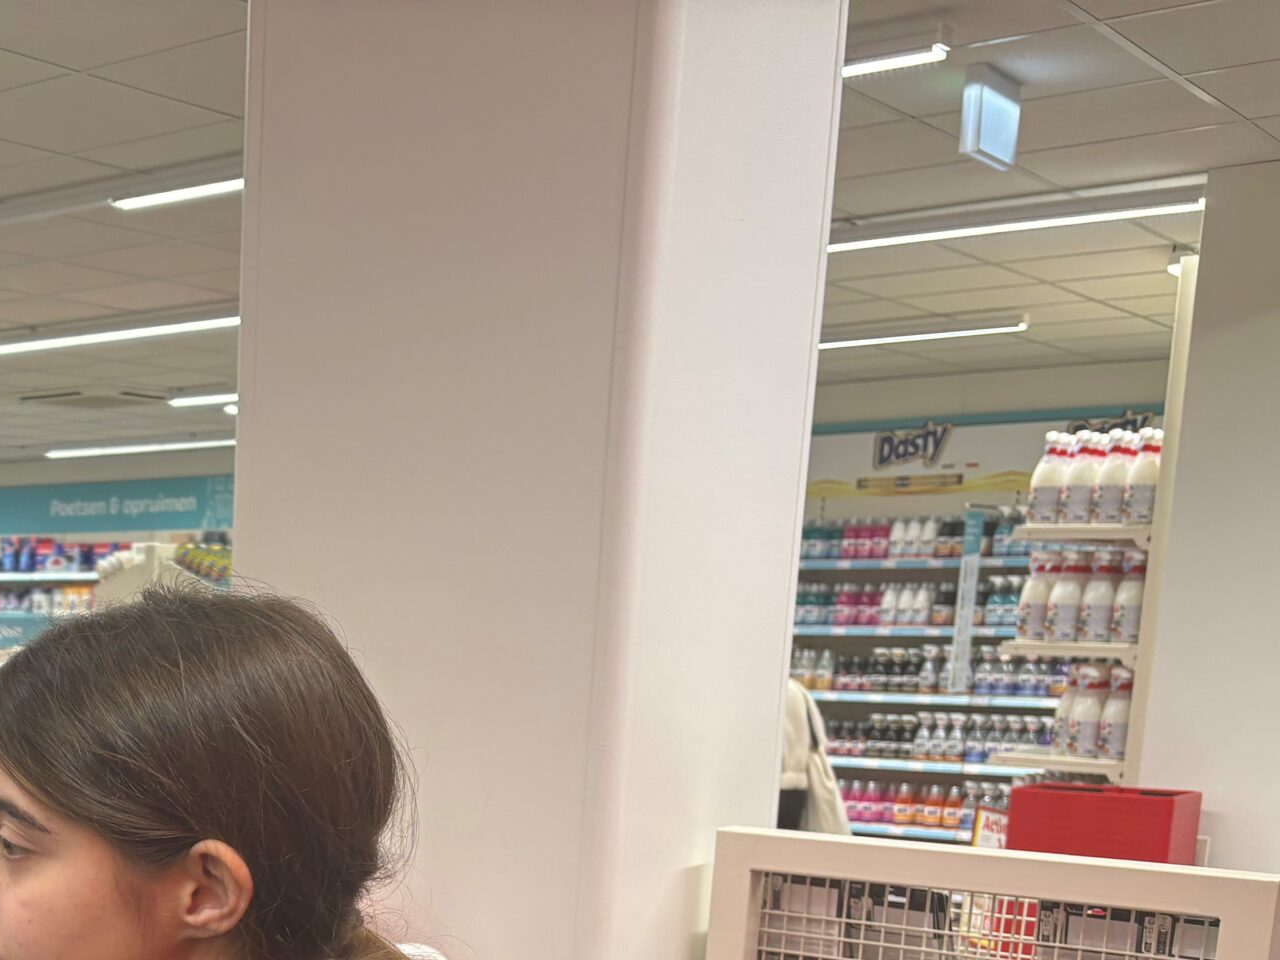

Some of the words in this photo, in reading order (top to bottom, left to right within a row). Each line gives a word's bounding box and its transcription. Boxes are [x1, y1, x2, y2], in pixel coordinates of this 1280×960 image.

[877, 424, 949, 465] Dasty
[49, 498, 107, 517] Poetsen
[122, 495, 198, 517] opruimen
